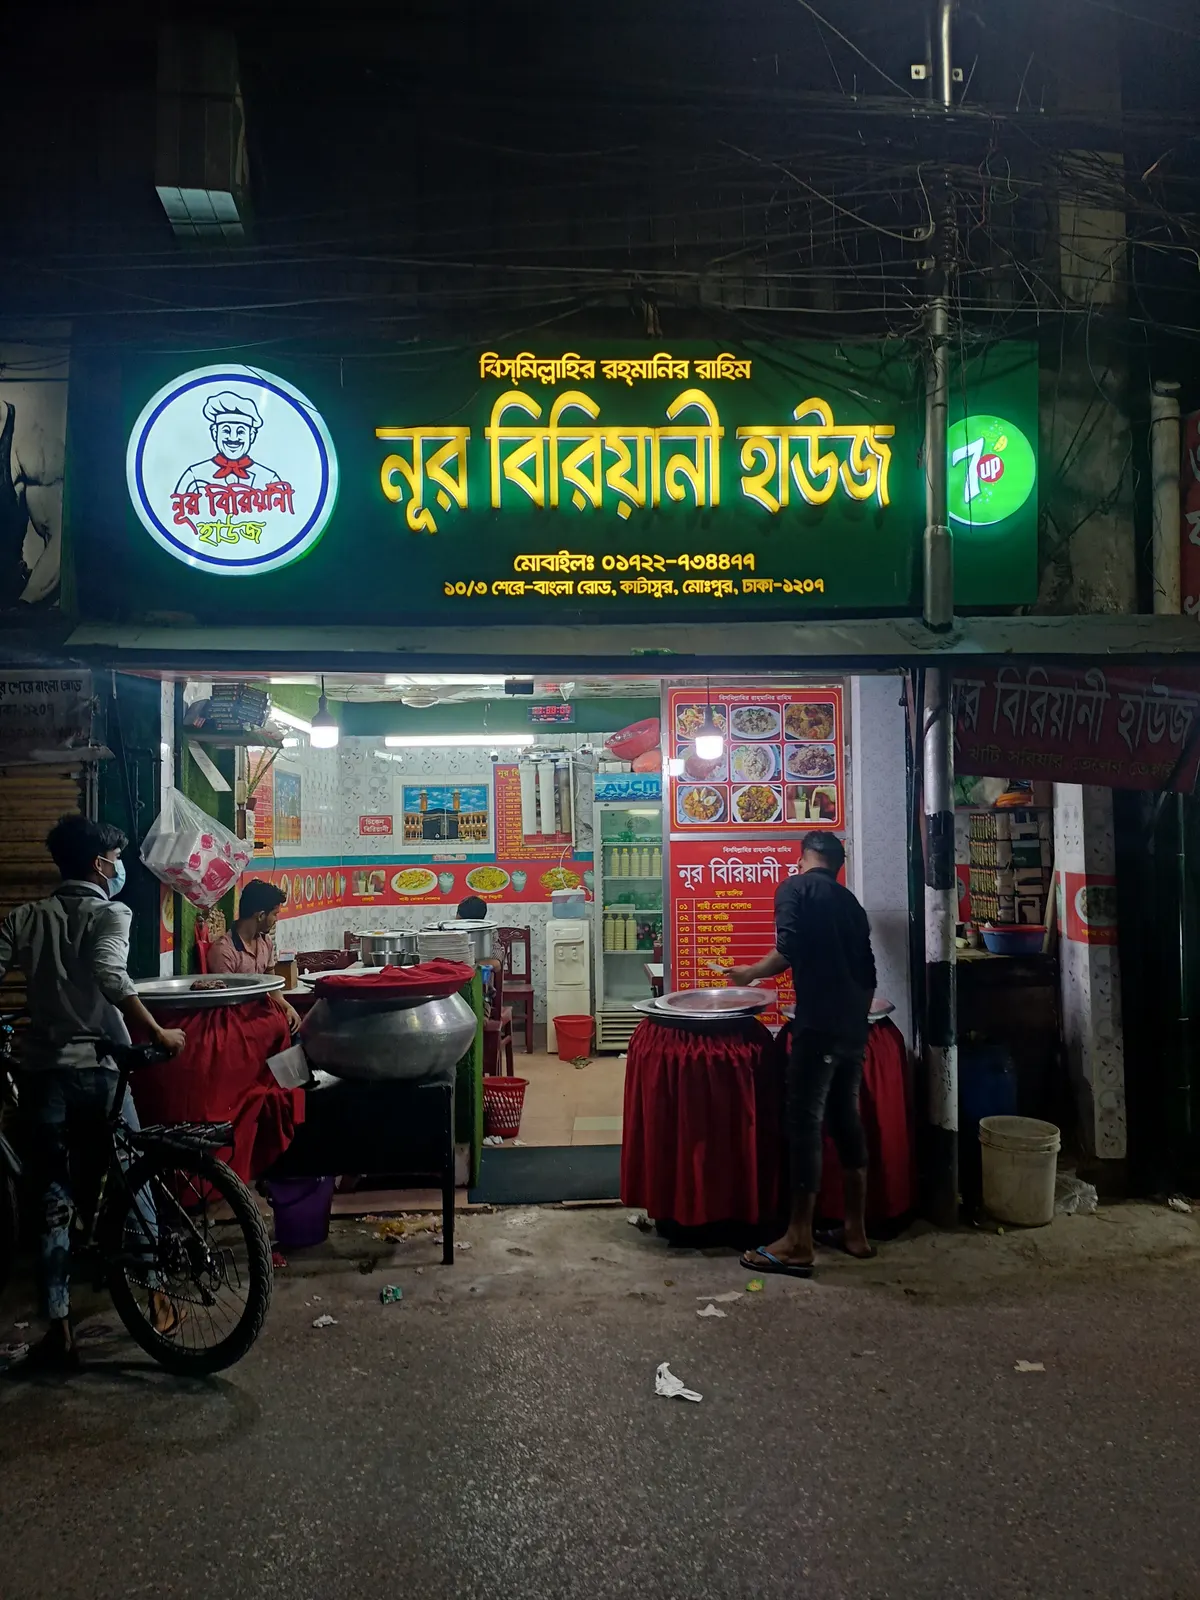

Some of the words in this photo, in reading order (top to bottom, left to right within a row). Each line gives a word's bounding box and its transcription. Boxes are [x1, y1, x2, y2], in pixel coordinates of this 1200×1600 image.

[694, 353, 751, 380] রাহিম
[376, 427, 470, 532] নূর
[485, 389, 724, 518] বিরিয়ানী
[736, 398, 894, 512] হাউজ
[170, 493, 203, 535] নূর
[205, 481, 296, 517] বিরিয়ানী
[196, 513, 266, 547] হাউজ
[602, 554, 754, 572] ০১৭২২-৭৩৪৪৭৭
[445, 581, 487, 596] ১০/৩
[577, 581, 616, 596] রোড,
[742, 579, 823, 593] ঢাকা-১২০৭
[992, 666, 1111, 749] বিরিয়ানী
[1117, 678, 1199, 755] হাউজ
[677, 865, 704, 890] নূর
[708, 857, 781, 883] বিরিয়ানী
